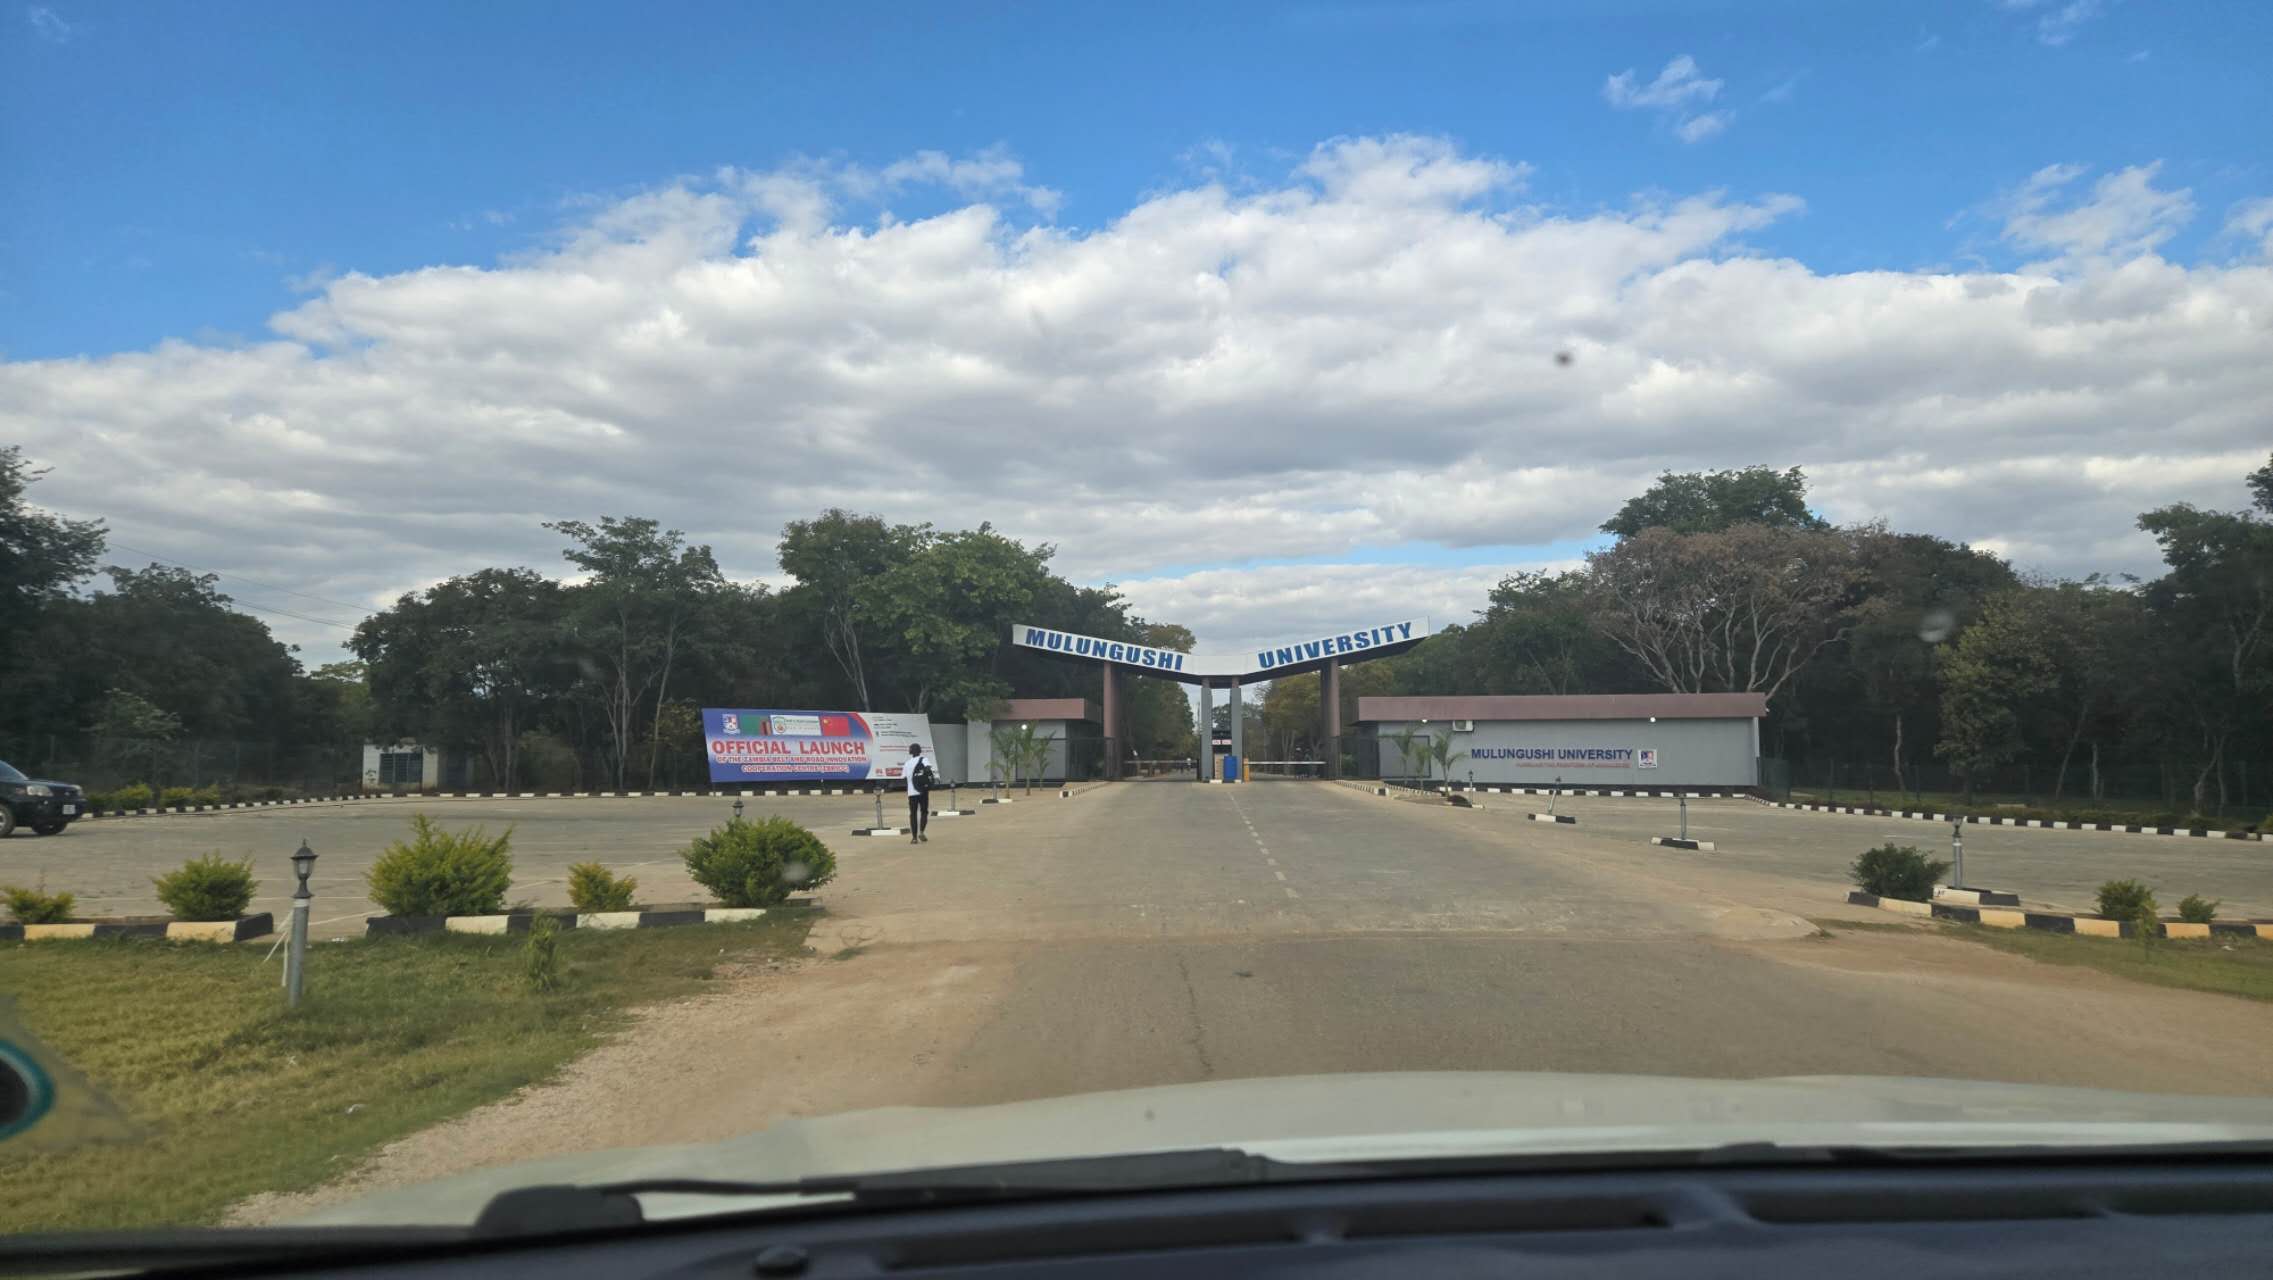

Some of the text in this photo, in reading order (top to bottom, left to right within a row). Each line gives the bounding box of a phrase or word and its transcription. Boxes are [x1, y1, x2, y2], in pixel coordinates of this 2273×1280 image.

[1025, 622, 1412, 671] MULUNGUSHI UNIVERSITY
[711, 740, 792, 755] OFFICIAL
[799, 740, 866, 755] LAUNCH
[1471, 748, 1633, 760] MULUNGUSHI UNIVERSITY
